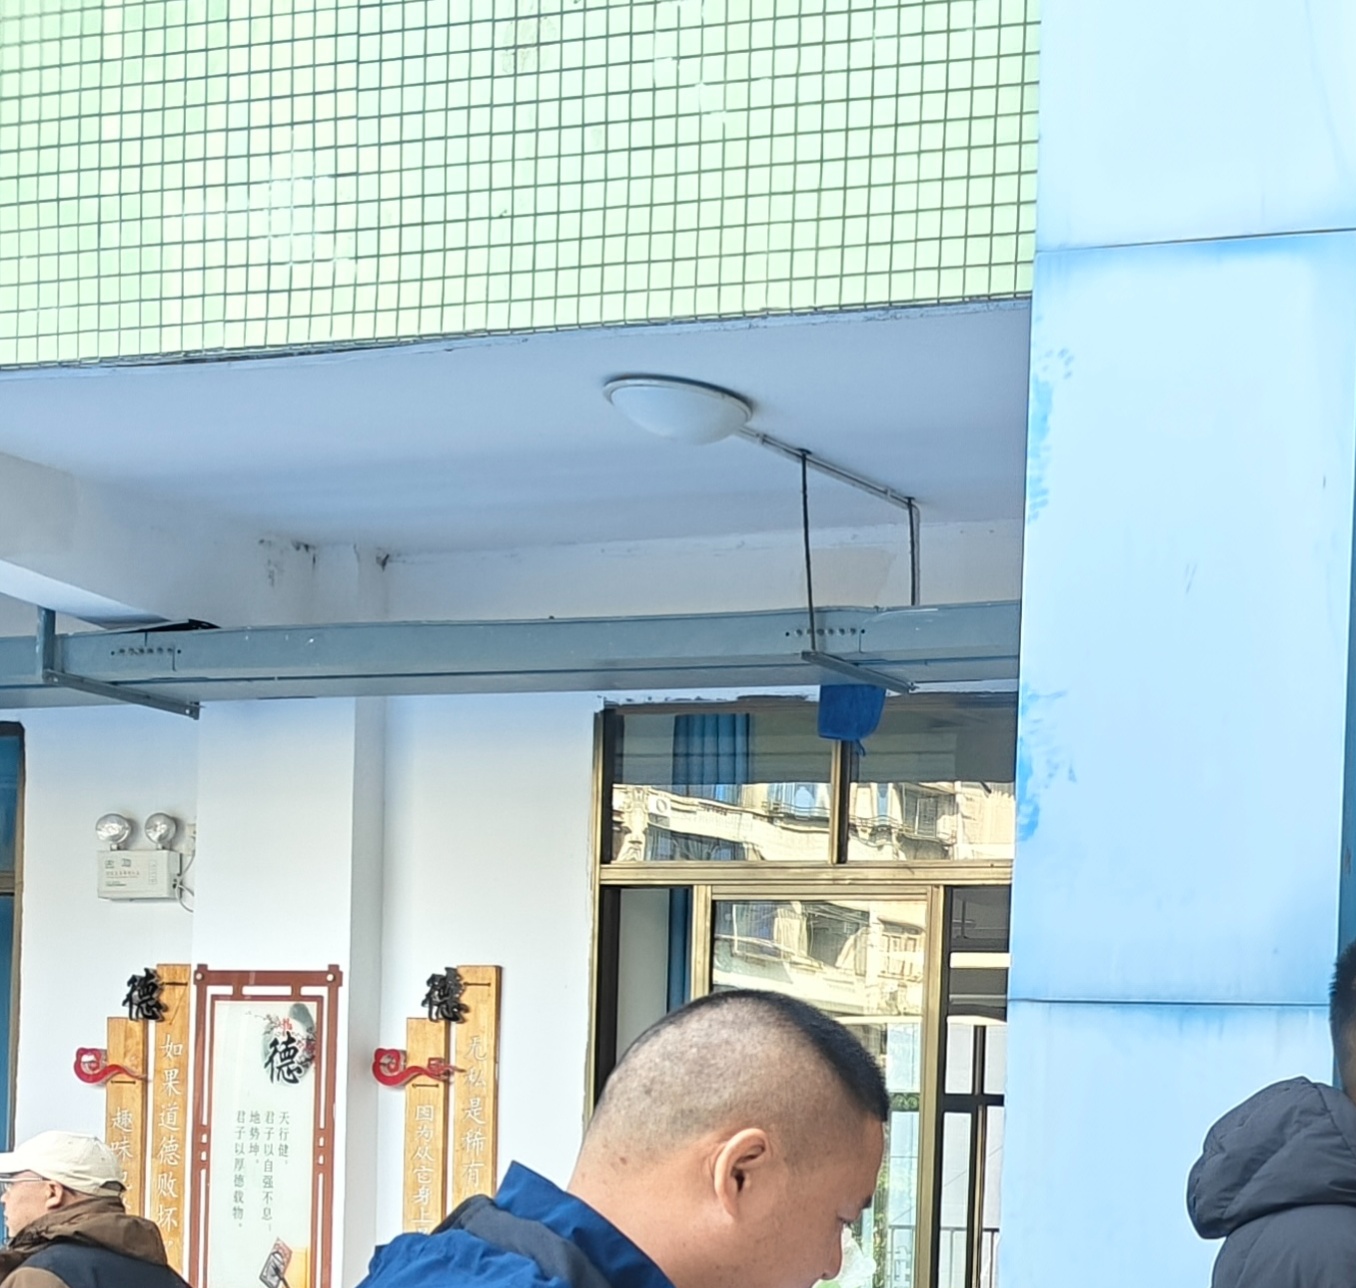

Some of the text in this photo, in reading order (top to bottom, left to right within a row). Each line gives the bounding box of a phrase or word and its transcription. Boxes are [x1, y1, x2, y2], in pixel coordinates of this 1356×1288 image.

[122, 967, 167, 1022] 德
[264, 1031, 303, 1084] 德
[463, 1035, 487, 1189] 无私是稀有
[411, 1104, 435, 1234] 因为从它身上
